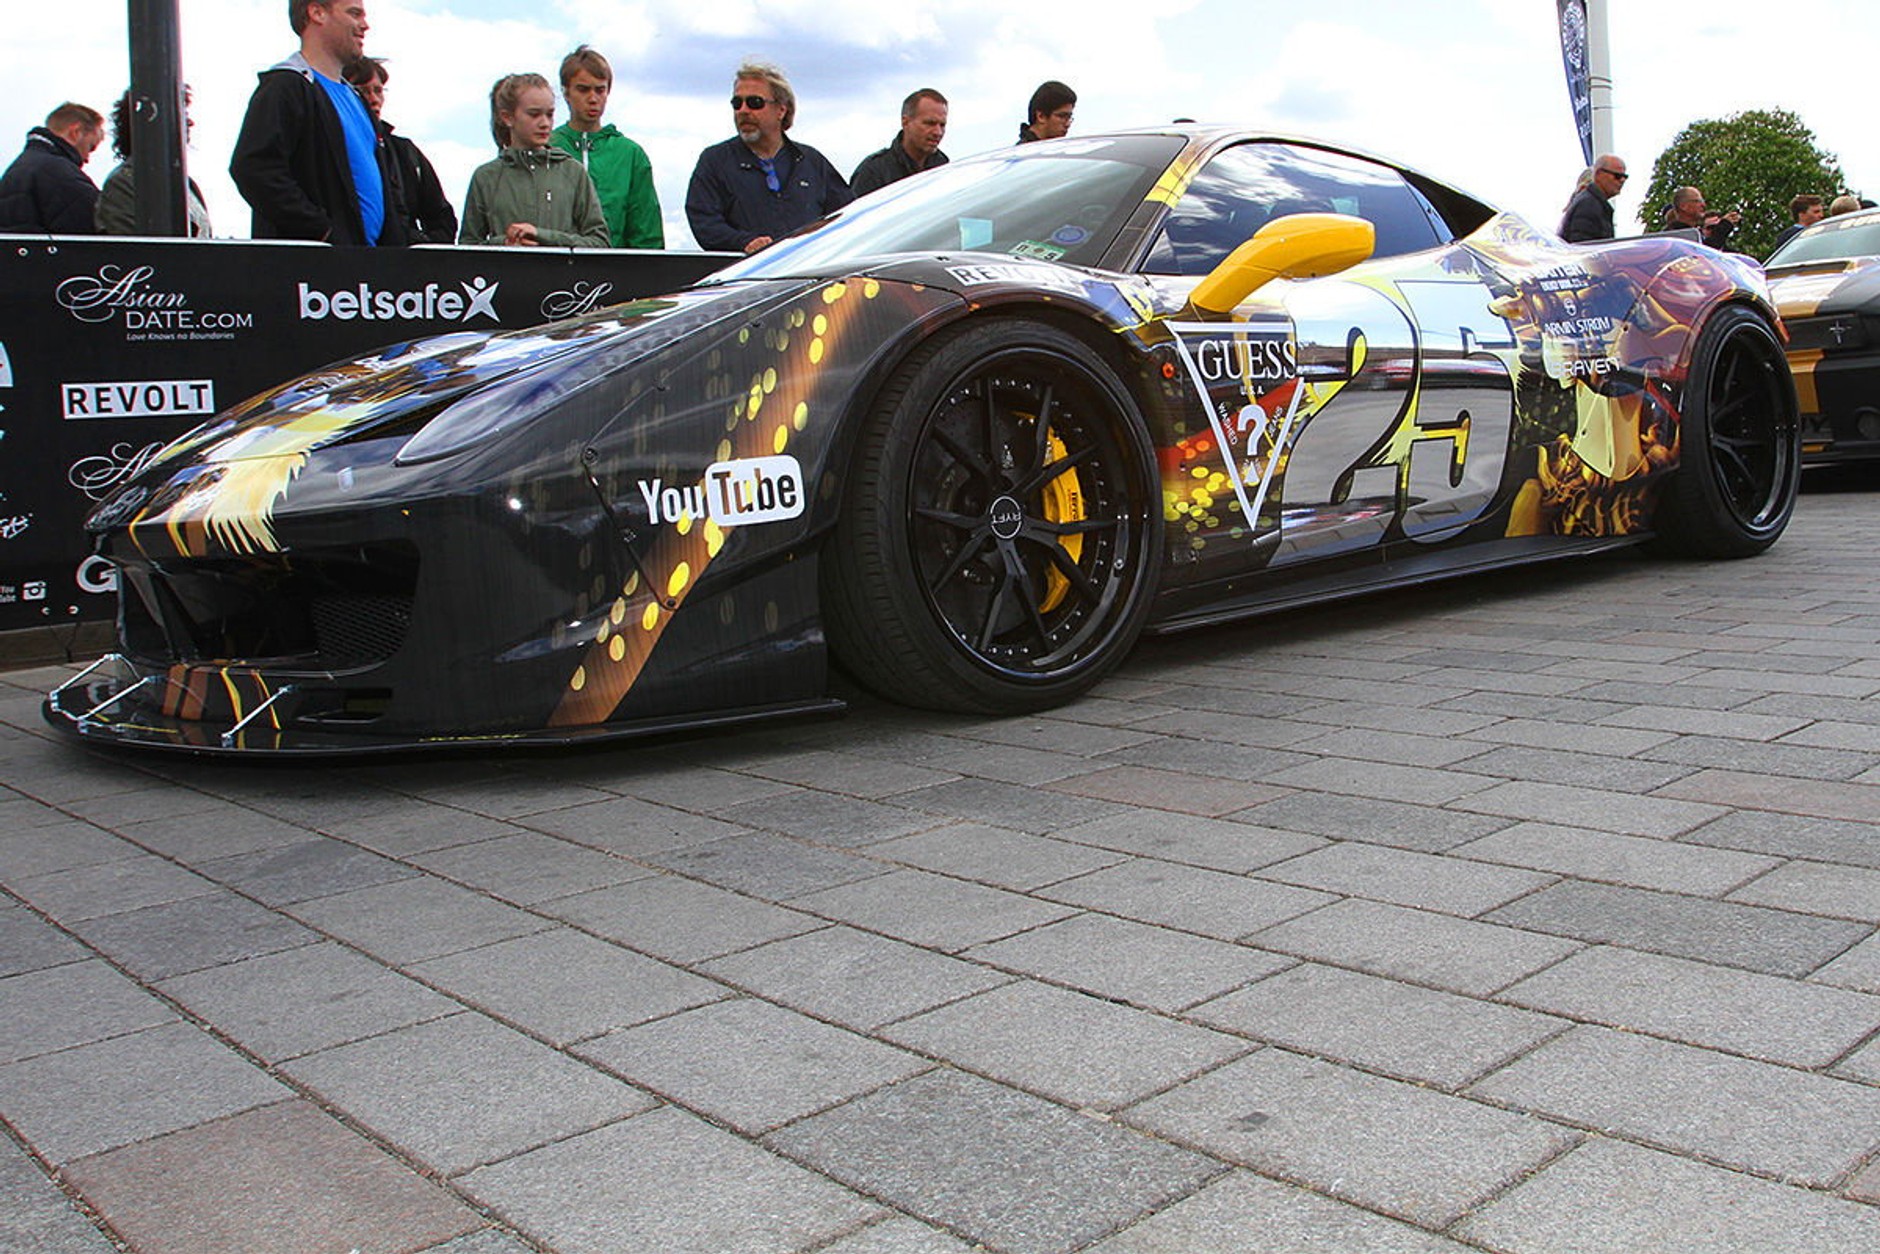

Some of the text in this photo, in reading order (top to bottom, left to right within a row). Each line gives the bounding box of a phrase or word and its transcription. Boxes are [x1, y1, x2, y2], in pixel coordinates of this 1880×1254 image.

[56, 264, 187, 322] Asian
[298, 282, 463, 320] betsafe
[126, 310, 253, 329] DATE.COM
[1198, 339, 1296, 380] GUESS
[67, 384, 209, 415] REVOLT
